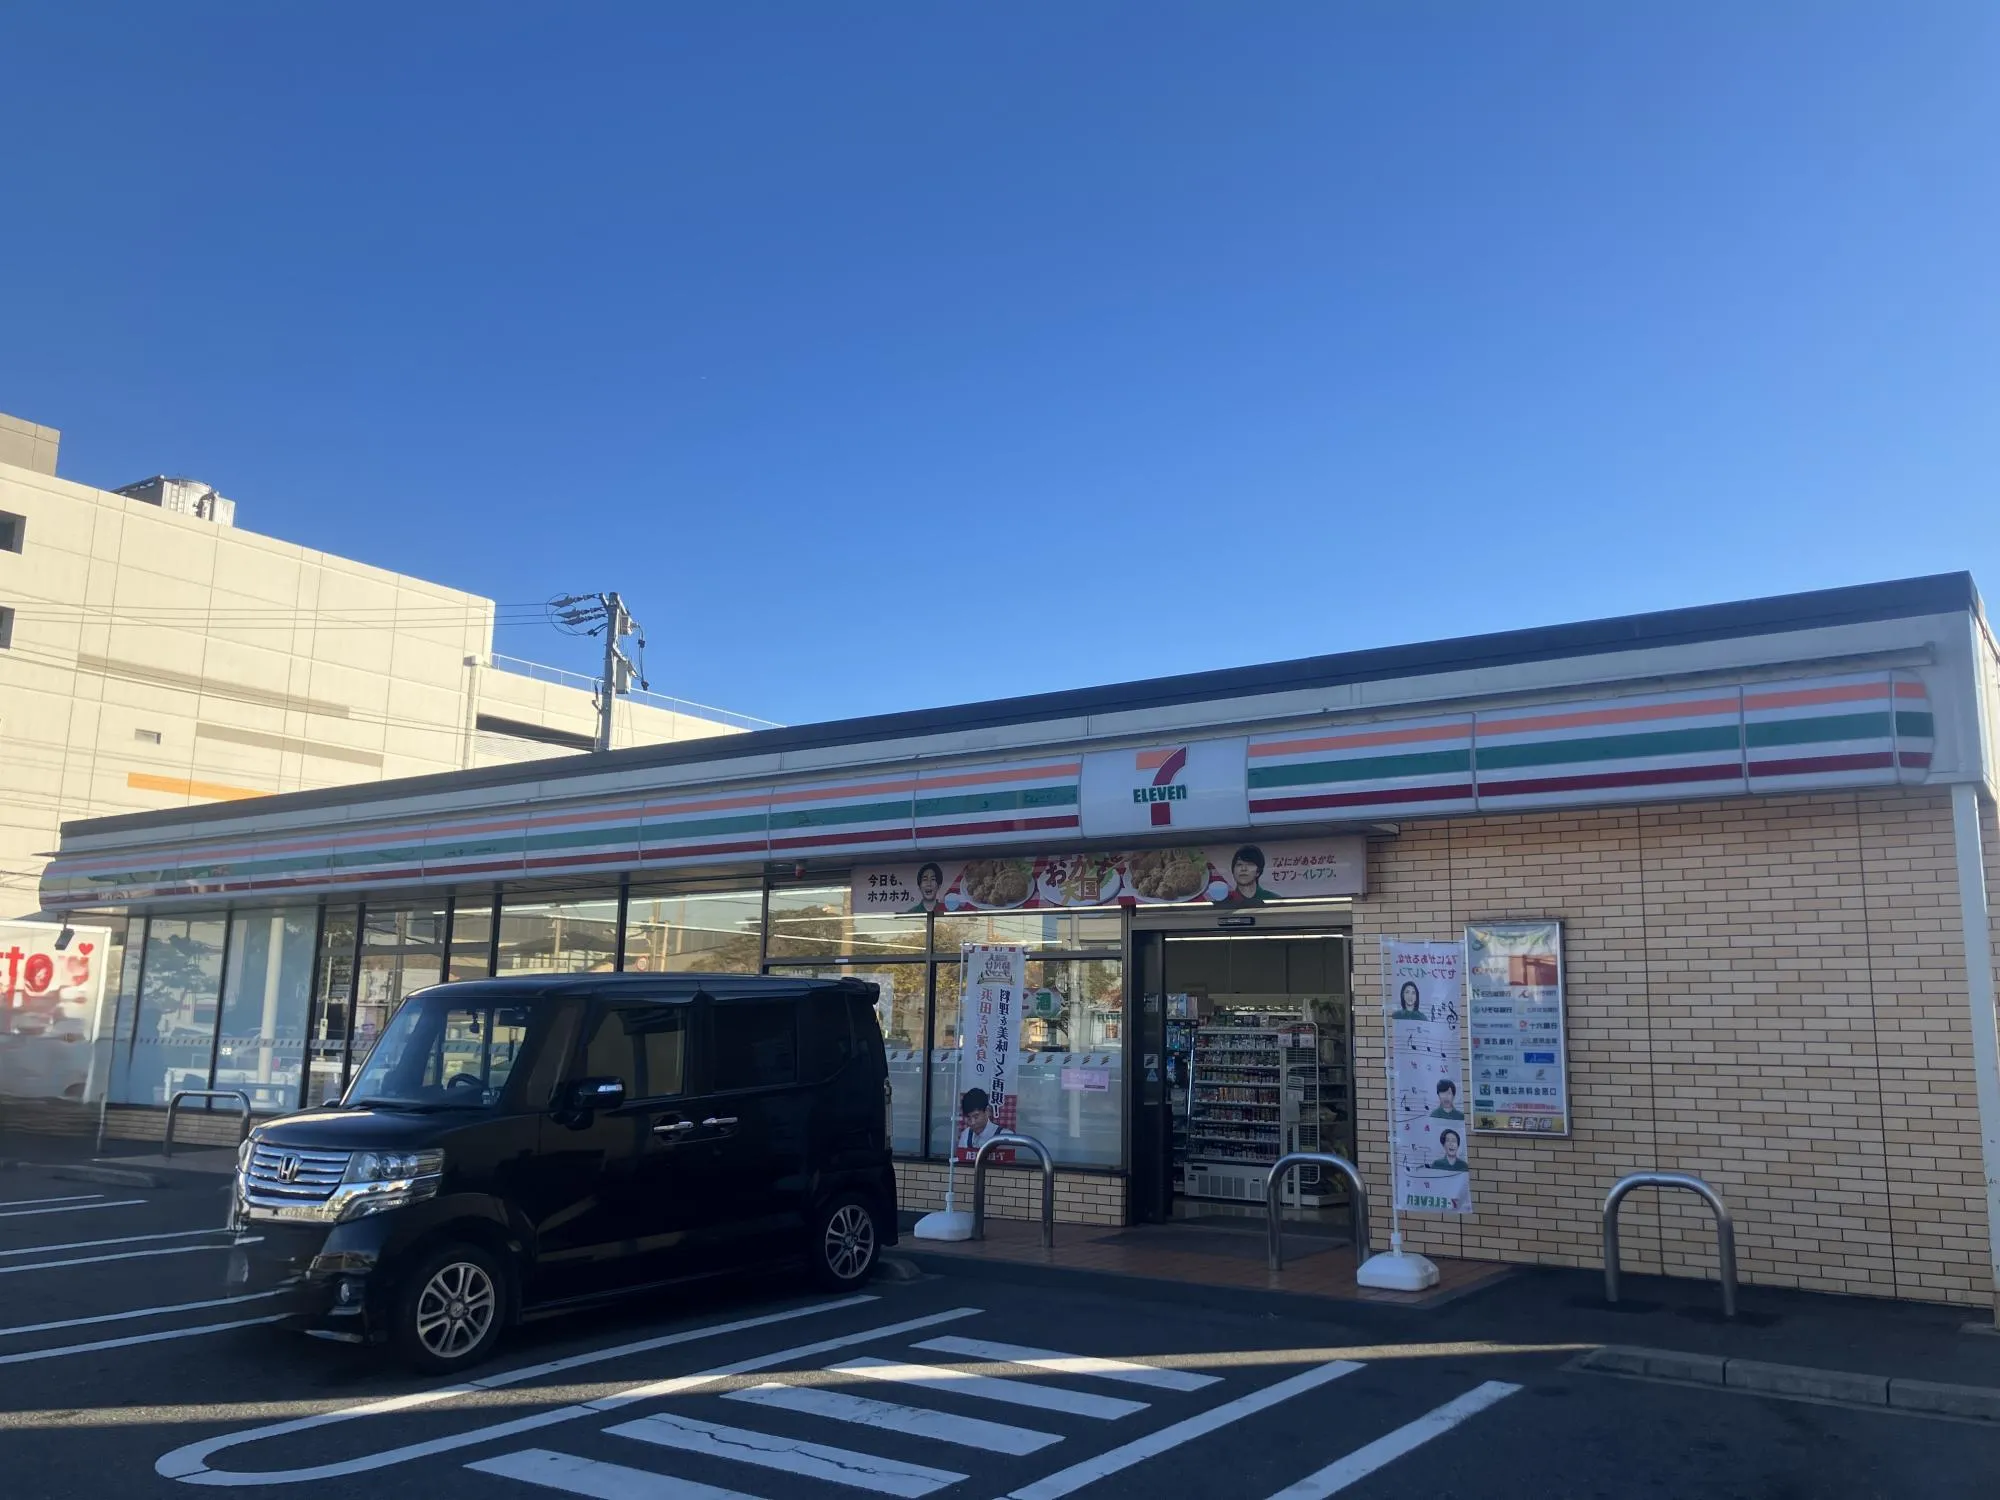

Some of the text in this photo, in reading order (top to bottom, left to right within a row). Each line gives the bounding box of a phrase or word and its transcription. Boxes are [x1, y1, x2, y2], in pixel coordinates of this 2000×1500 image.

[868, 874, 904, 886] 今日も、
[867, 889, 916, 902] ホカホカ。
